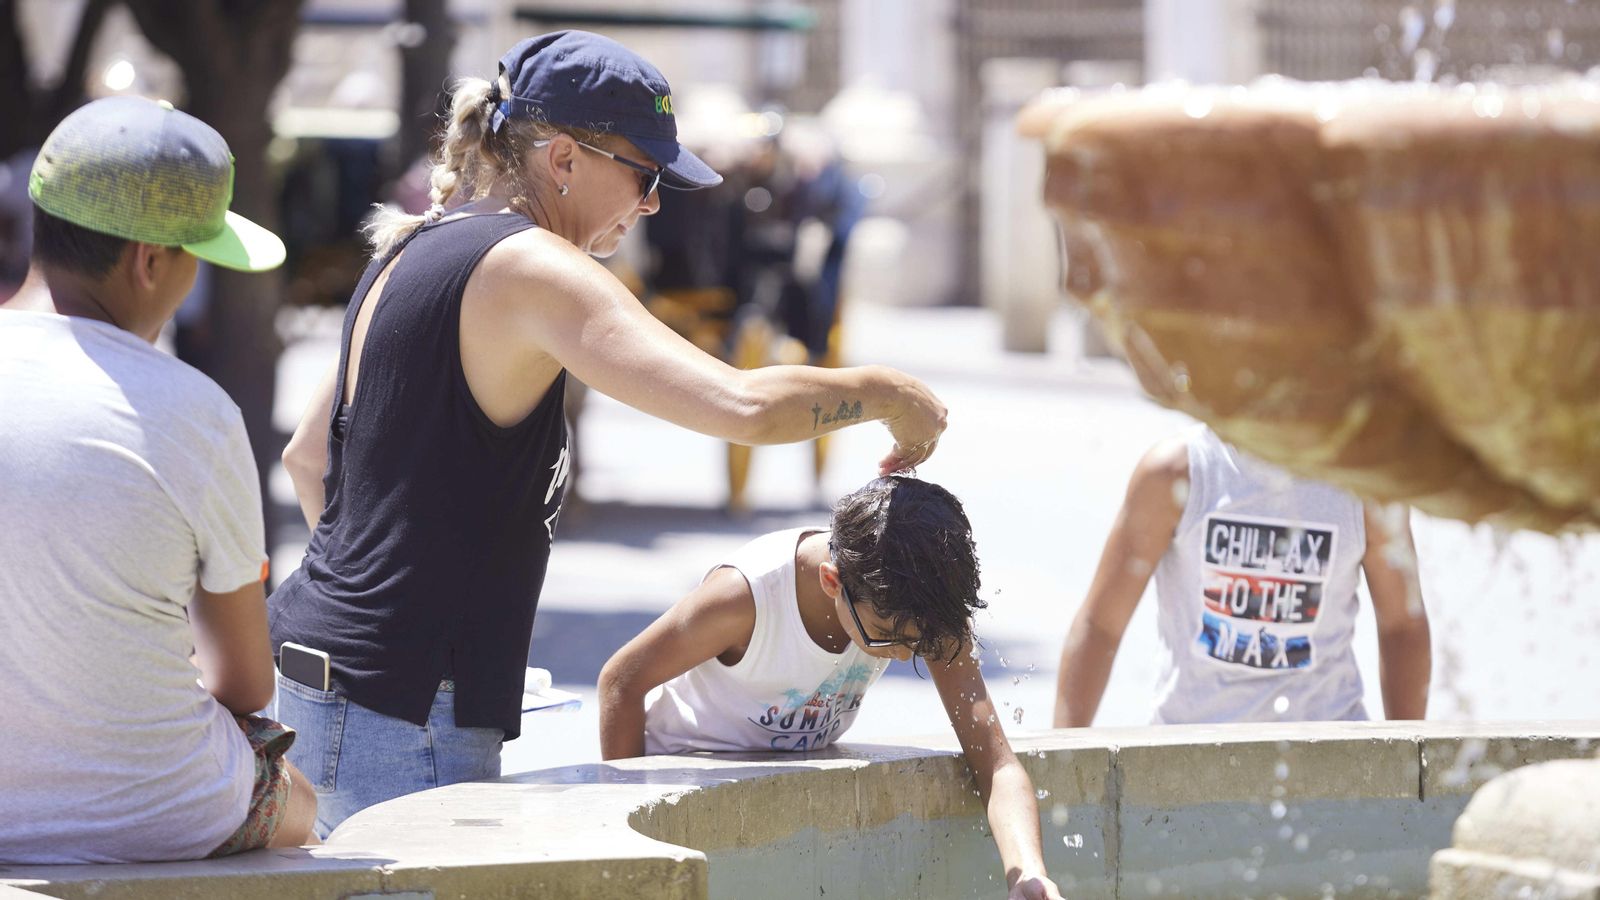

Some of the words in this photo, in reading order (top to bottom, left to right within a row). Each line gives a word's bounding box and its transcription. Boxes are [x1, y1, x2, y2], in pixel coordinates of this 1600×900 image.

[1210, 524, 1324, 573] CHILLAX
[1215, 576, 1250, 615] TO
[1258, 580, 1307, 622] THE
[1214, 621, 1290, 668] MAX
